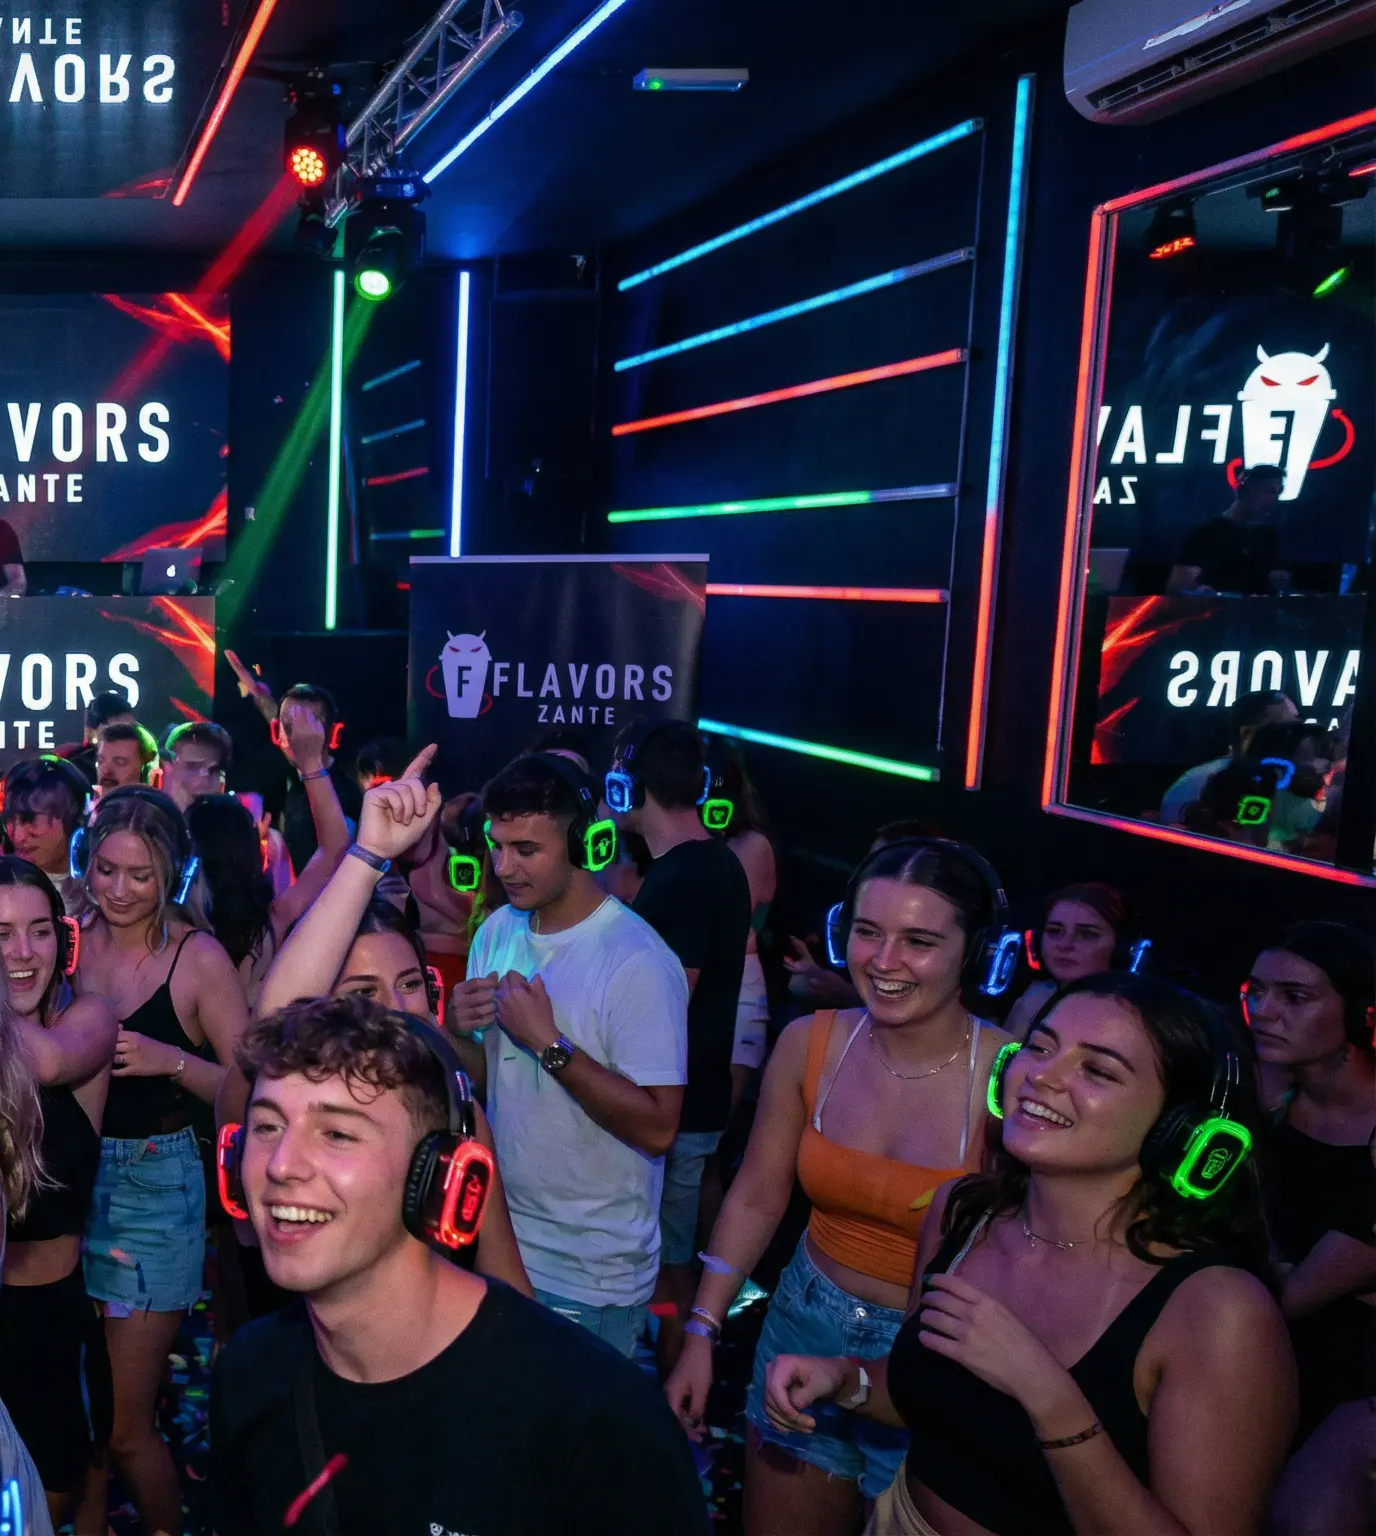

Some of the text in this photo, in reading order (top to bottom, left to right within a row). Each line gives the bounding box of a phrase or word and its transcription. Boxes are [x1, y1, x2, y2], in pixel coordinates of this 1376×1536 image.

[457, 666, 472, 698] F
[492, 662, 674, 702] FLAVORS
[537, 704, 615, 725] ZANTE
